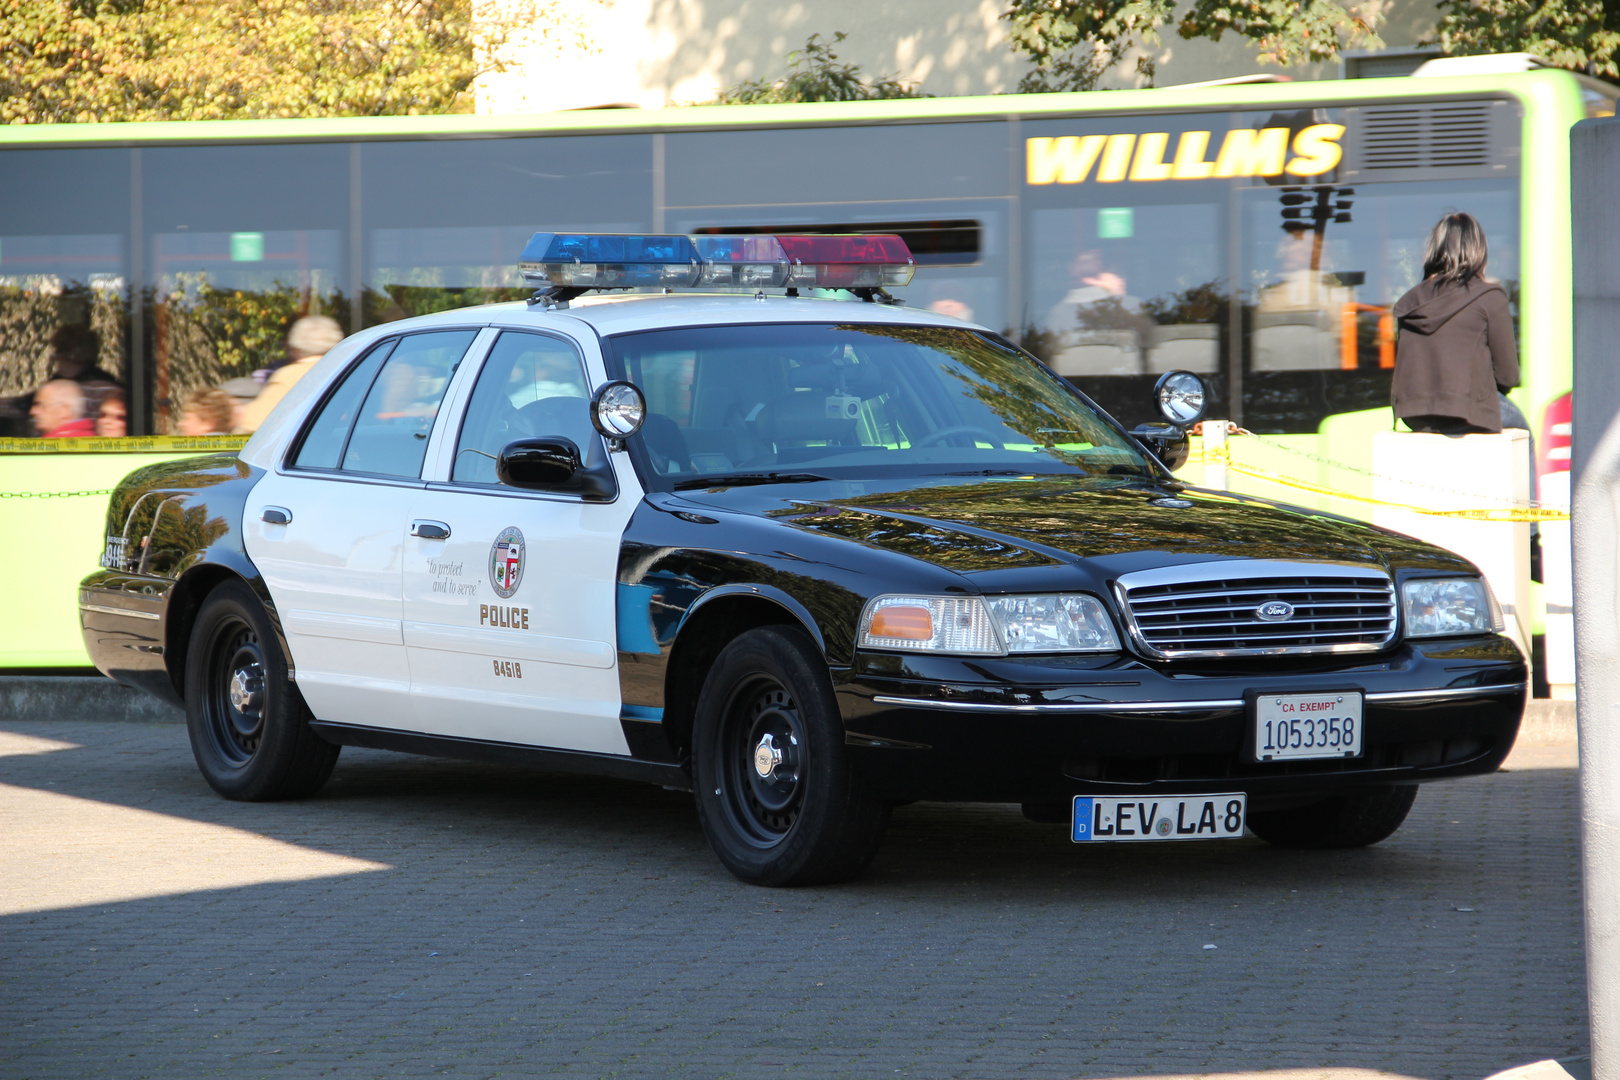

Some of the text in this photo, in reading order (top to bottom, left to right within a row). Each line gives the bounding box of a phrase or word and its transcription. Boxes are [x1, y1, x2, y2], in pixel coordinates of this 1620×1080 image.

[1026, 123, 1347, 185] WILLMS
[438, 561, 464, 578] protect
[432, 576, 448, 593] and
[449, 579, 456, 594] to
[480, 604, 529, 630] POLICE
[1267, 604, 1287, 614] Ford
[493, 660, 522, 678] 84518
[1282, 702, 1336, 713] CA EXEMPT
[1263, 717, 1355, 750] 1053358
[1079, 799, 1242, 836] D LEV LA 8
